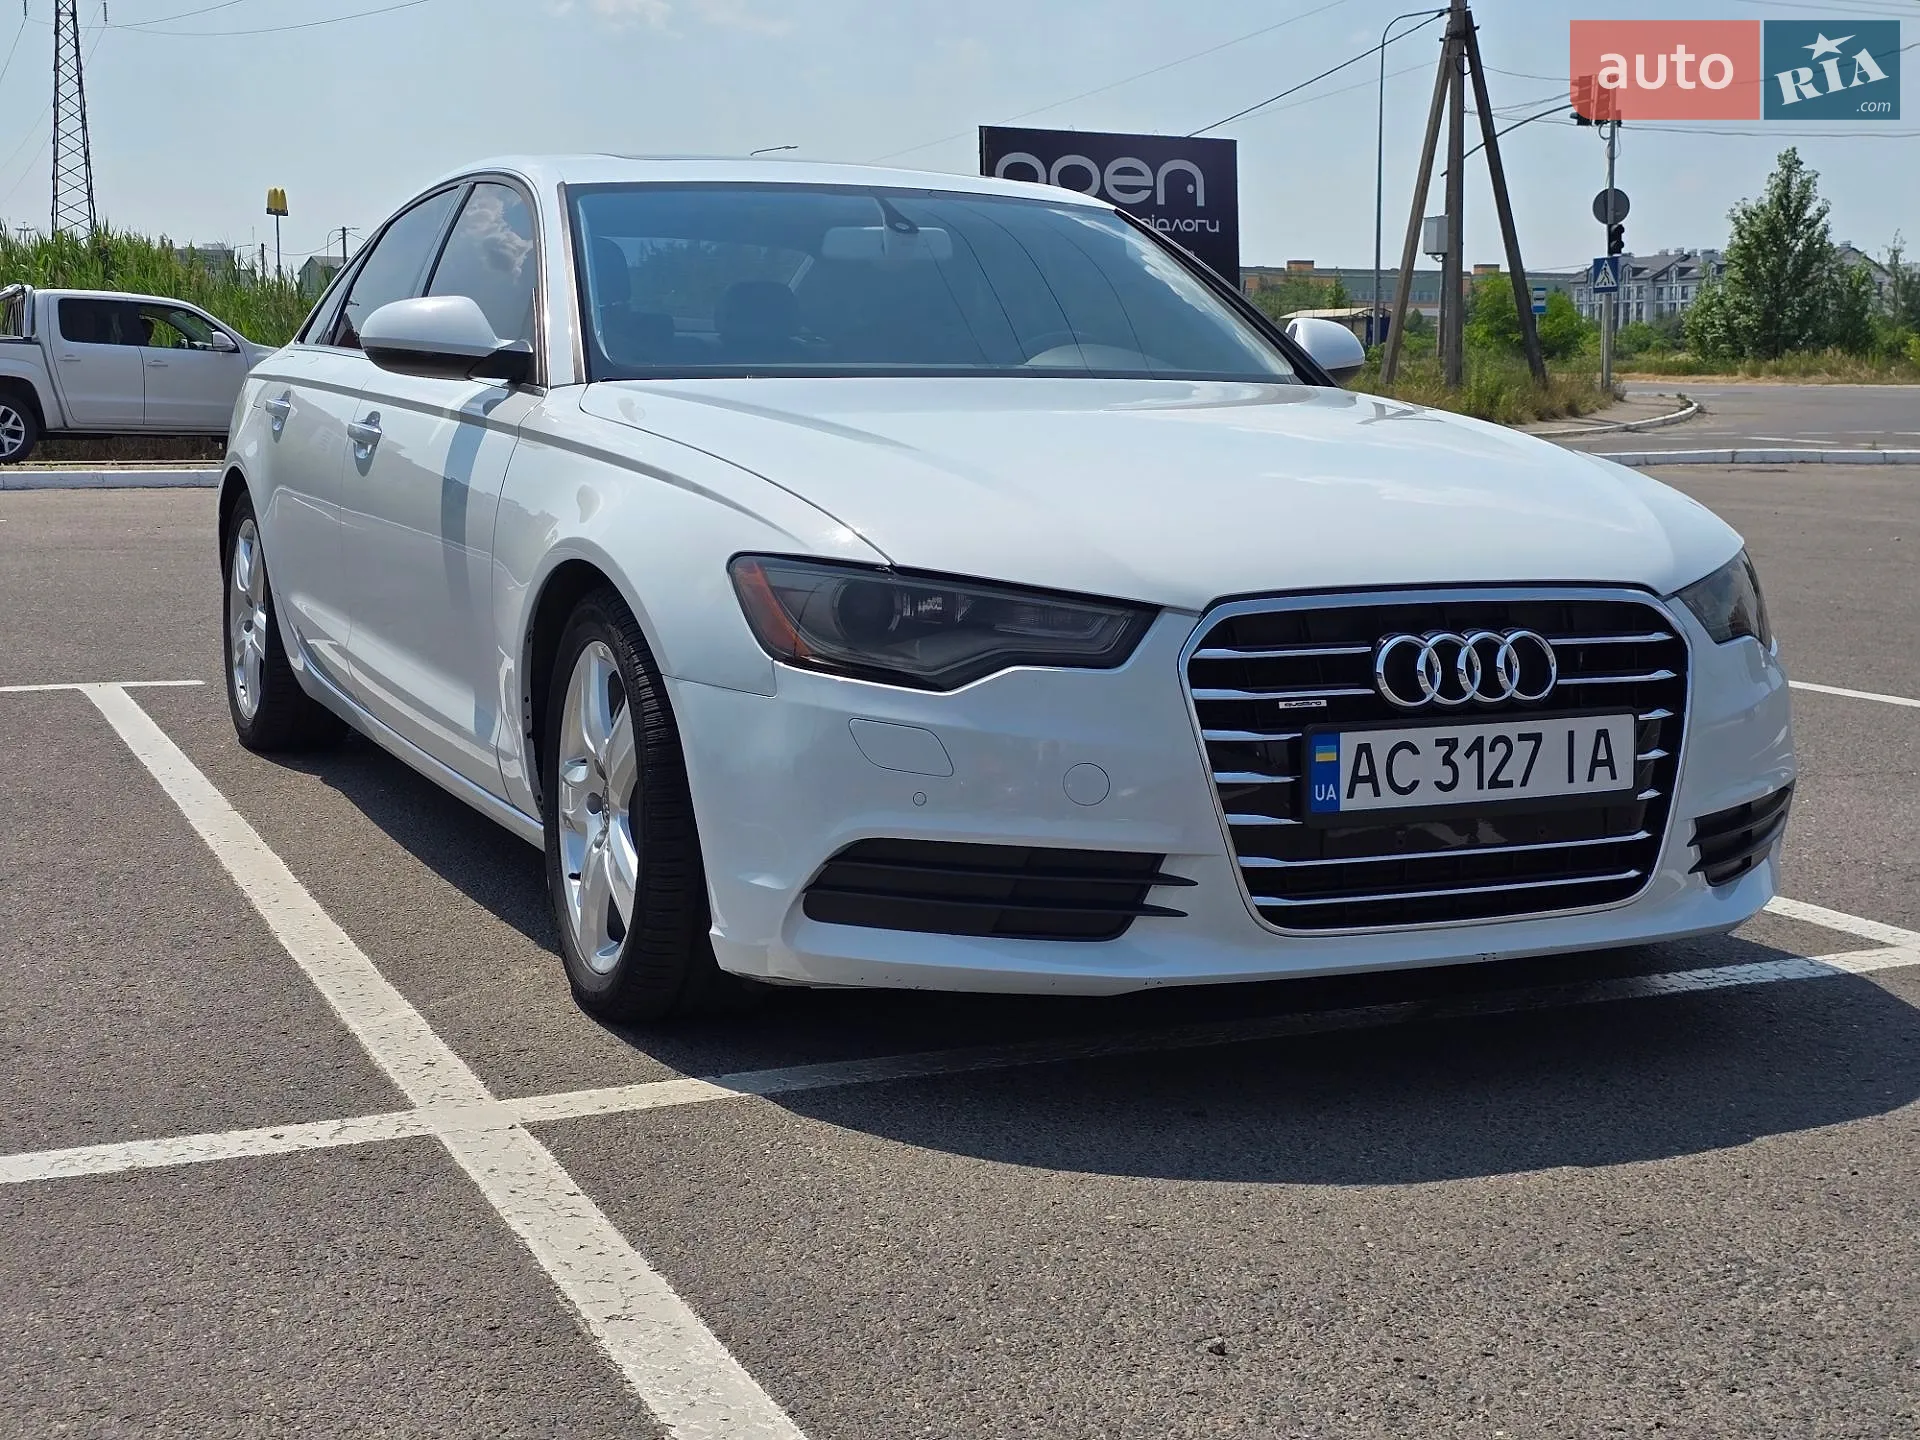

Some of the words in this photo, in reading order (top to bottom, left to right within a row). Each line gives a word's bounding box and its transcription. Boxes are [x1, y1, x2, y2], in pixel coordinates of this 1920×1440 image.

[1346, 740, 1421, 800] AC
[1433, 731, 1543, 793] 3127
[1567, 728, 1618, 784] IA
[1315, 784, 1337, 801] UA
